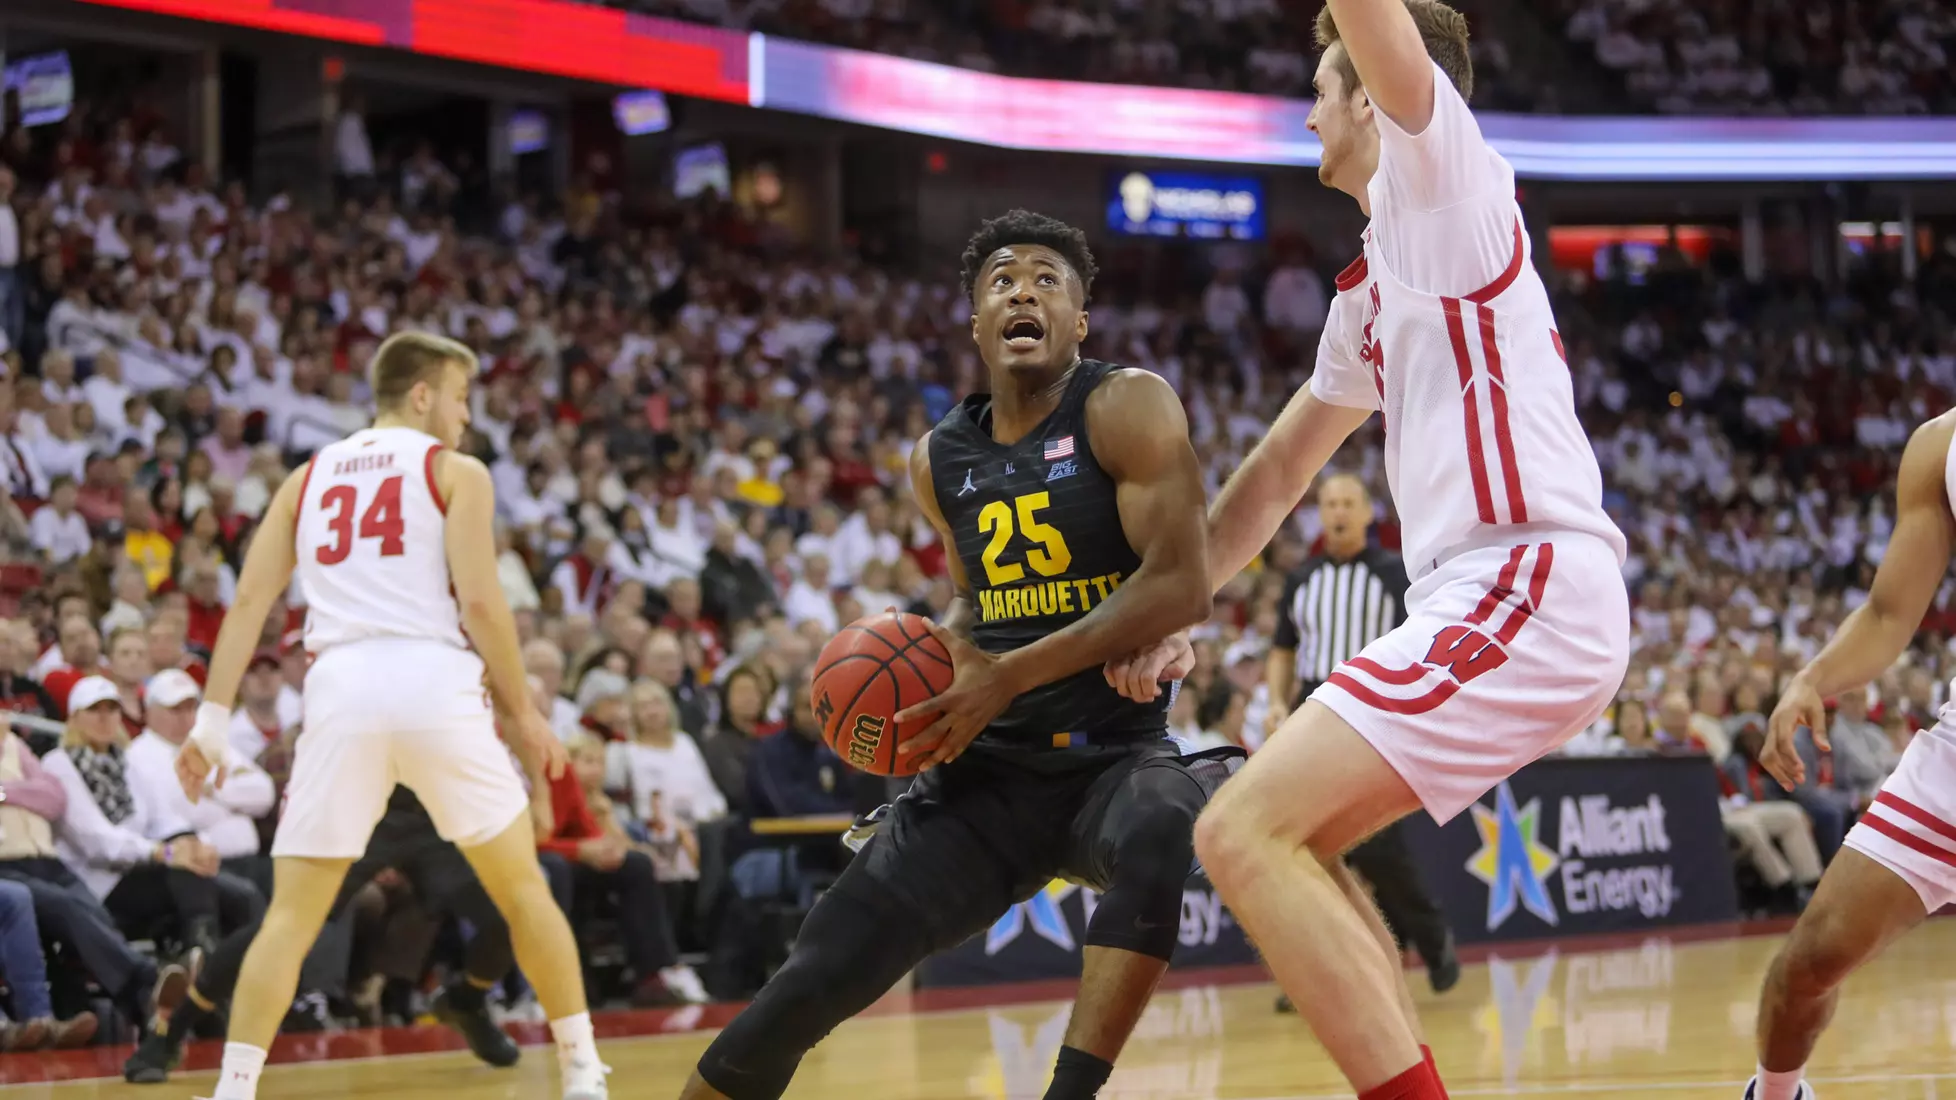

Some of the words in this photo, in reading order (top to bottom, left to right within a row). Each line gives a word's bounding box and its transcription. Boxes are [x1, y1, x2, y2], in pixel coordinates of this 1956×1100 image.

[1005, 462, 1016, 475] AL
[1047, 465, 1079, 479] EAST
[1051, 460, 1073, 473] BIG
[316, 475, 405, 566] 34
[978, 490, 1072, 586] 25
[1422, 625, 1510, 684] W
[1560, 794, 1671, 858] Alliant
[1560, 860, 1673, 918] Energy
